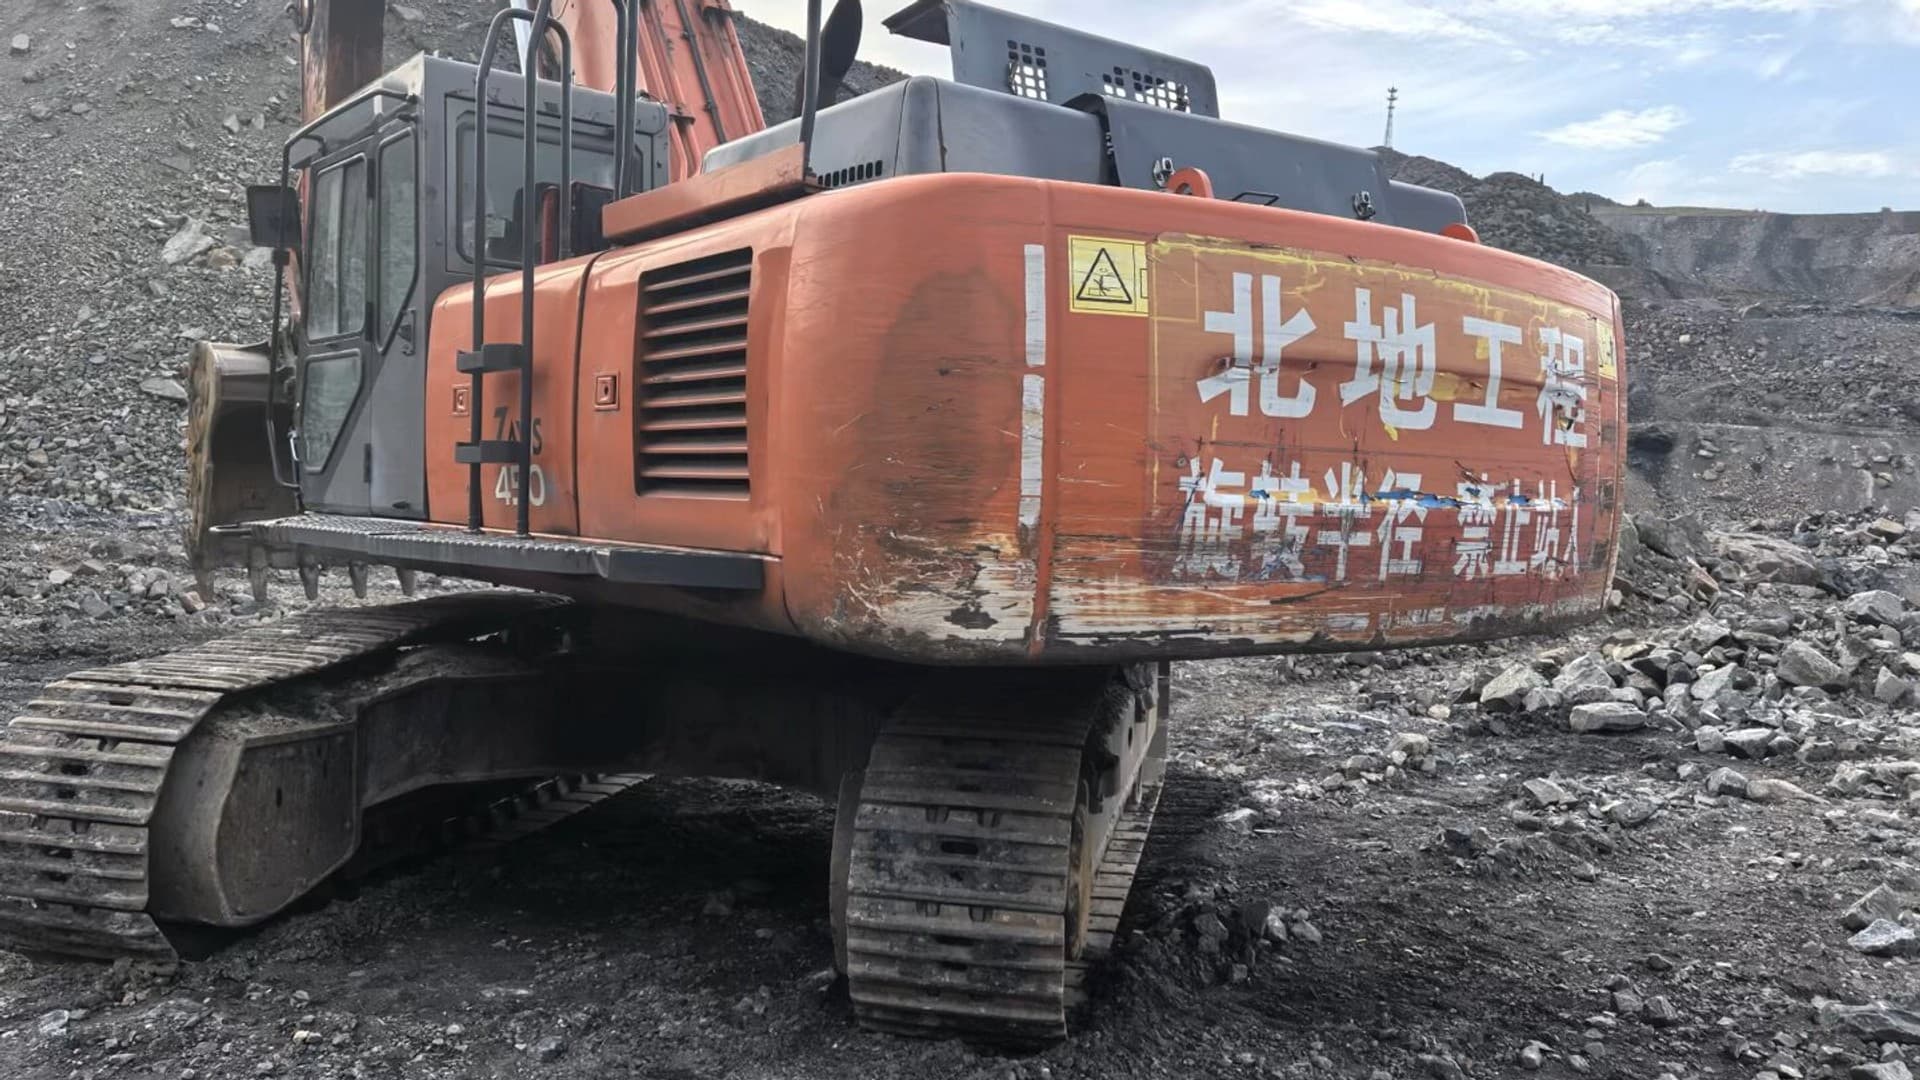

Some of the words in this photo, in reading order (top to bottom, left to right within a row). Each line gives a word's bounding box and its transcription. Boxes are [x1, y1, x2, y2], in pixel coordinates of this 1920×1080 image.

[1197, 272, 1587, 448] 北地工程
[493, 406, 543, 455] ZAS
